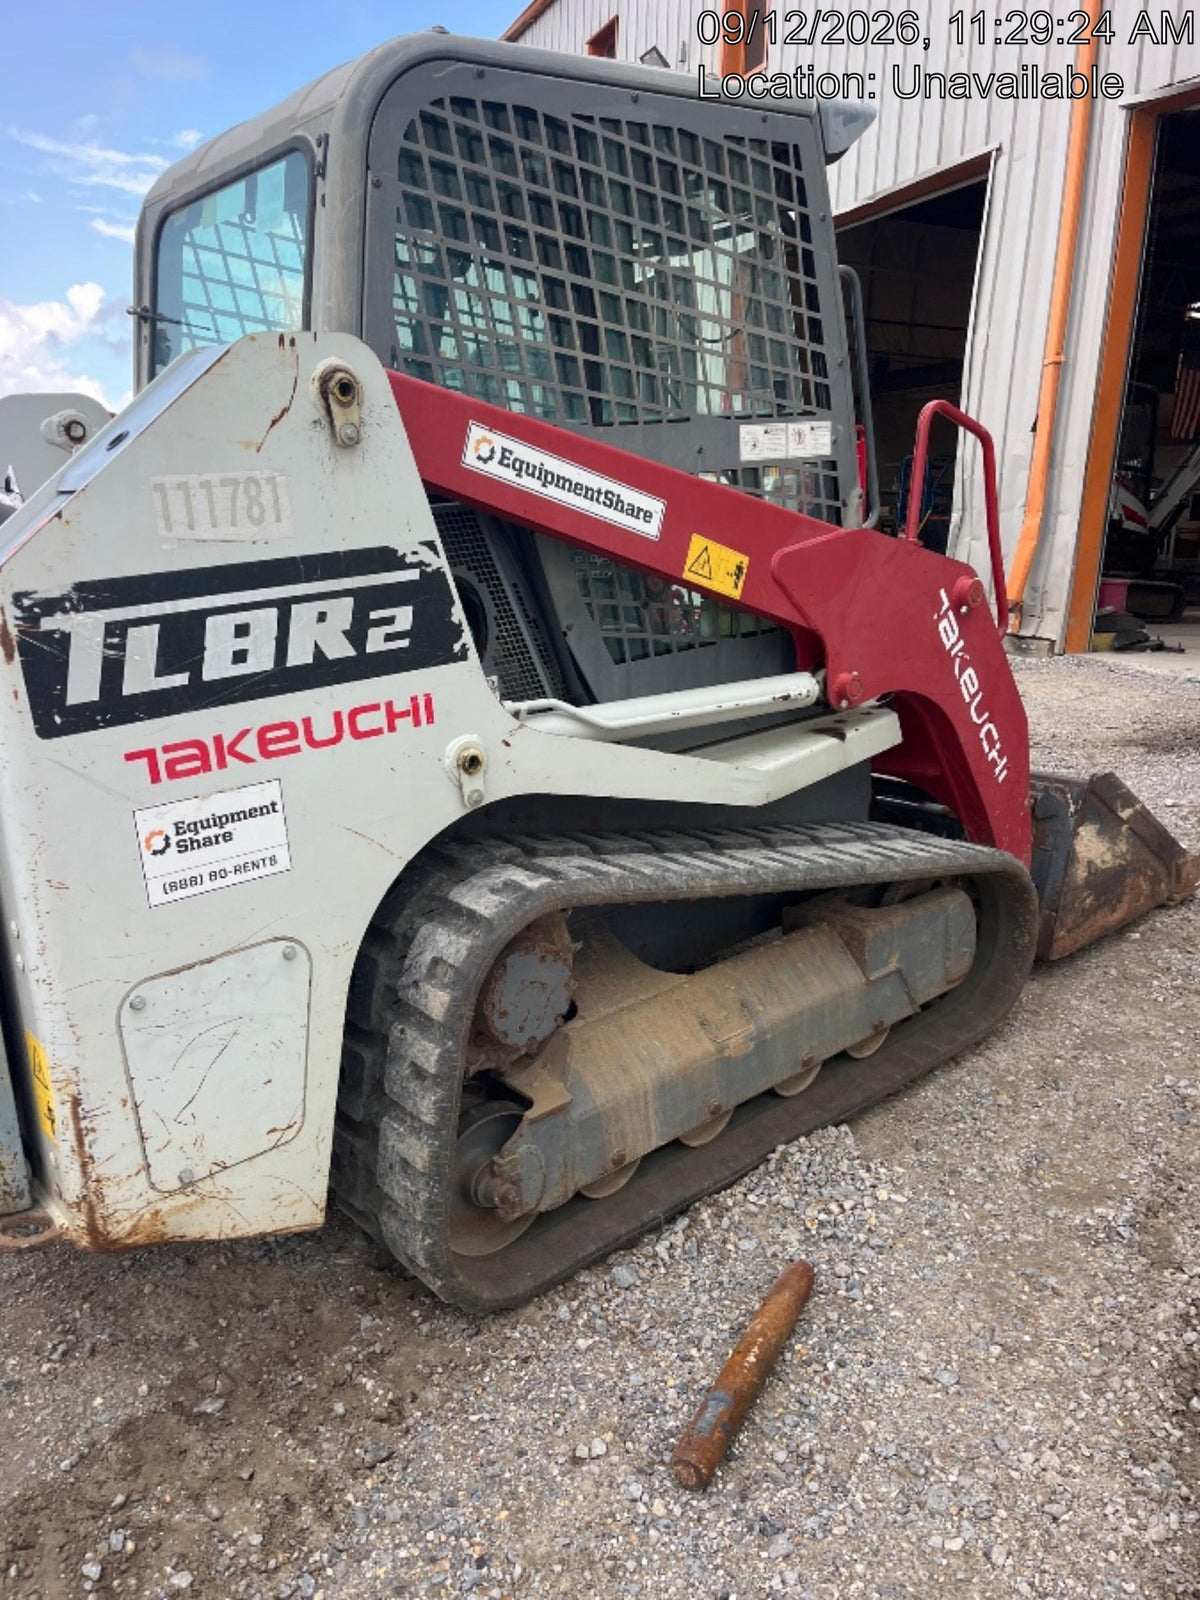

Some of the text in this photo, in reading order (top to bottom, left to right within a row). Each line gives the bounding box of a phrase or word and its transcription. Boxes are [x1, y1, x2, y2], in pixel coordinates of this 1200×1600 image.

[153, 475, 283, 533] 111781
[497, 447, 654, 524] EquipmentShare
[173, 800, 279, 837] Equipment
[175, 831, 234, 854] Share
